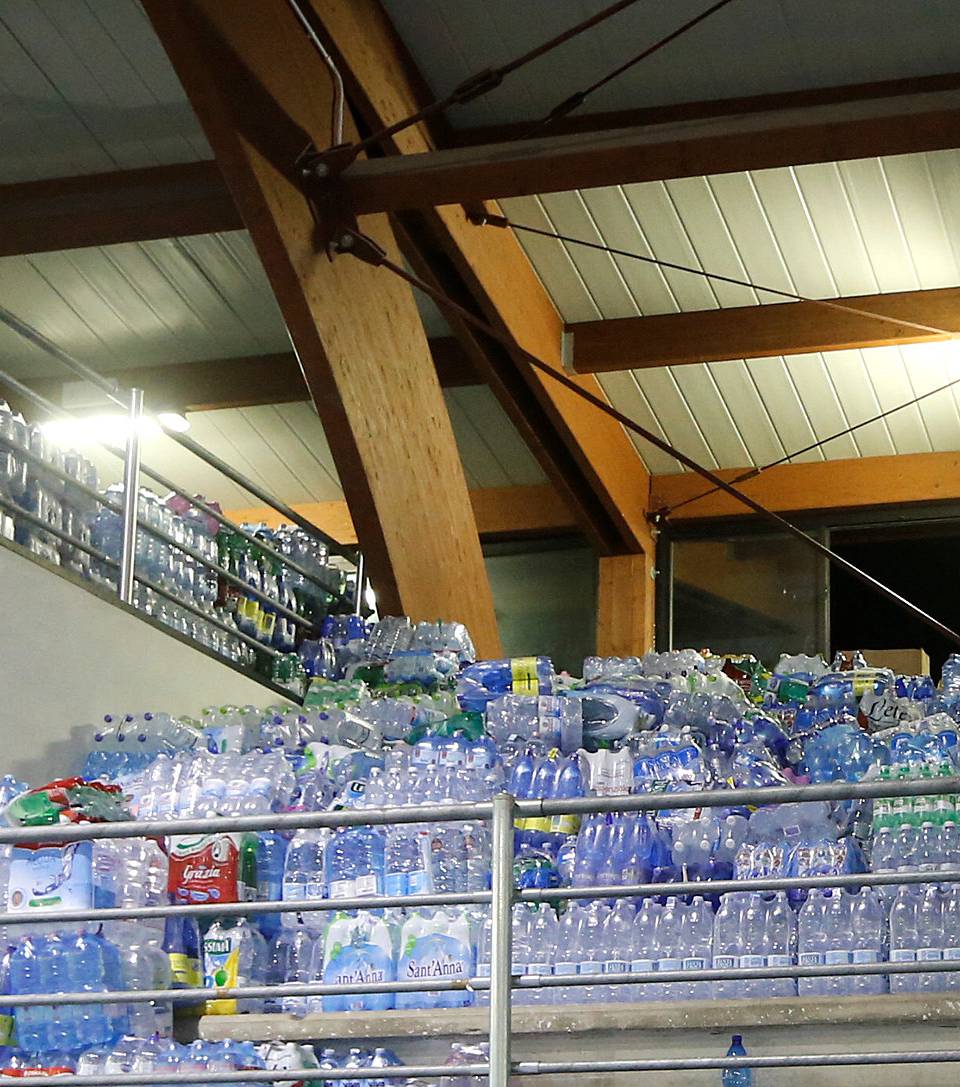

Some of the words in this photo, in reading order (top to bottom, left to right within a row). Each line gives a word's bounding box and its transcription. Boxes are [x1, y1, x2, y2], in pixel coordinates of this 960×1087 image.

[183, 864, 221, 885] Grazia
[336, 970, 383, 984] ant'Anna
[406, 960, 463, 978] Sant'Anna
